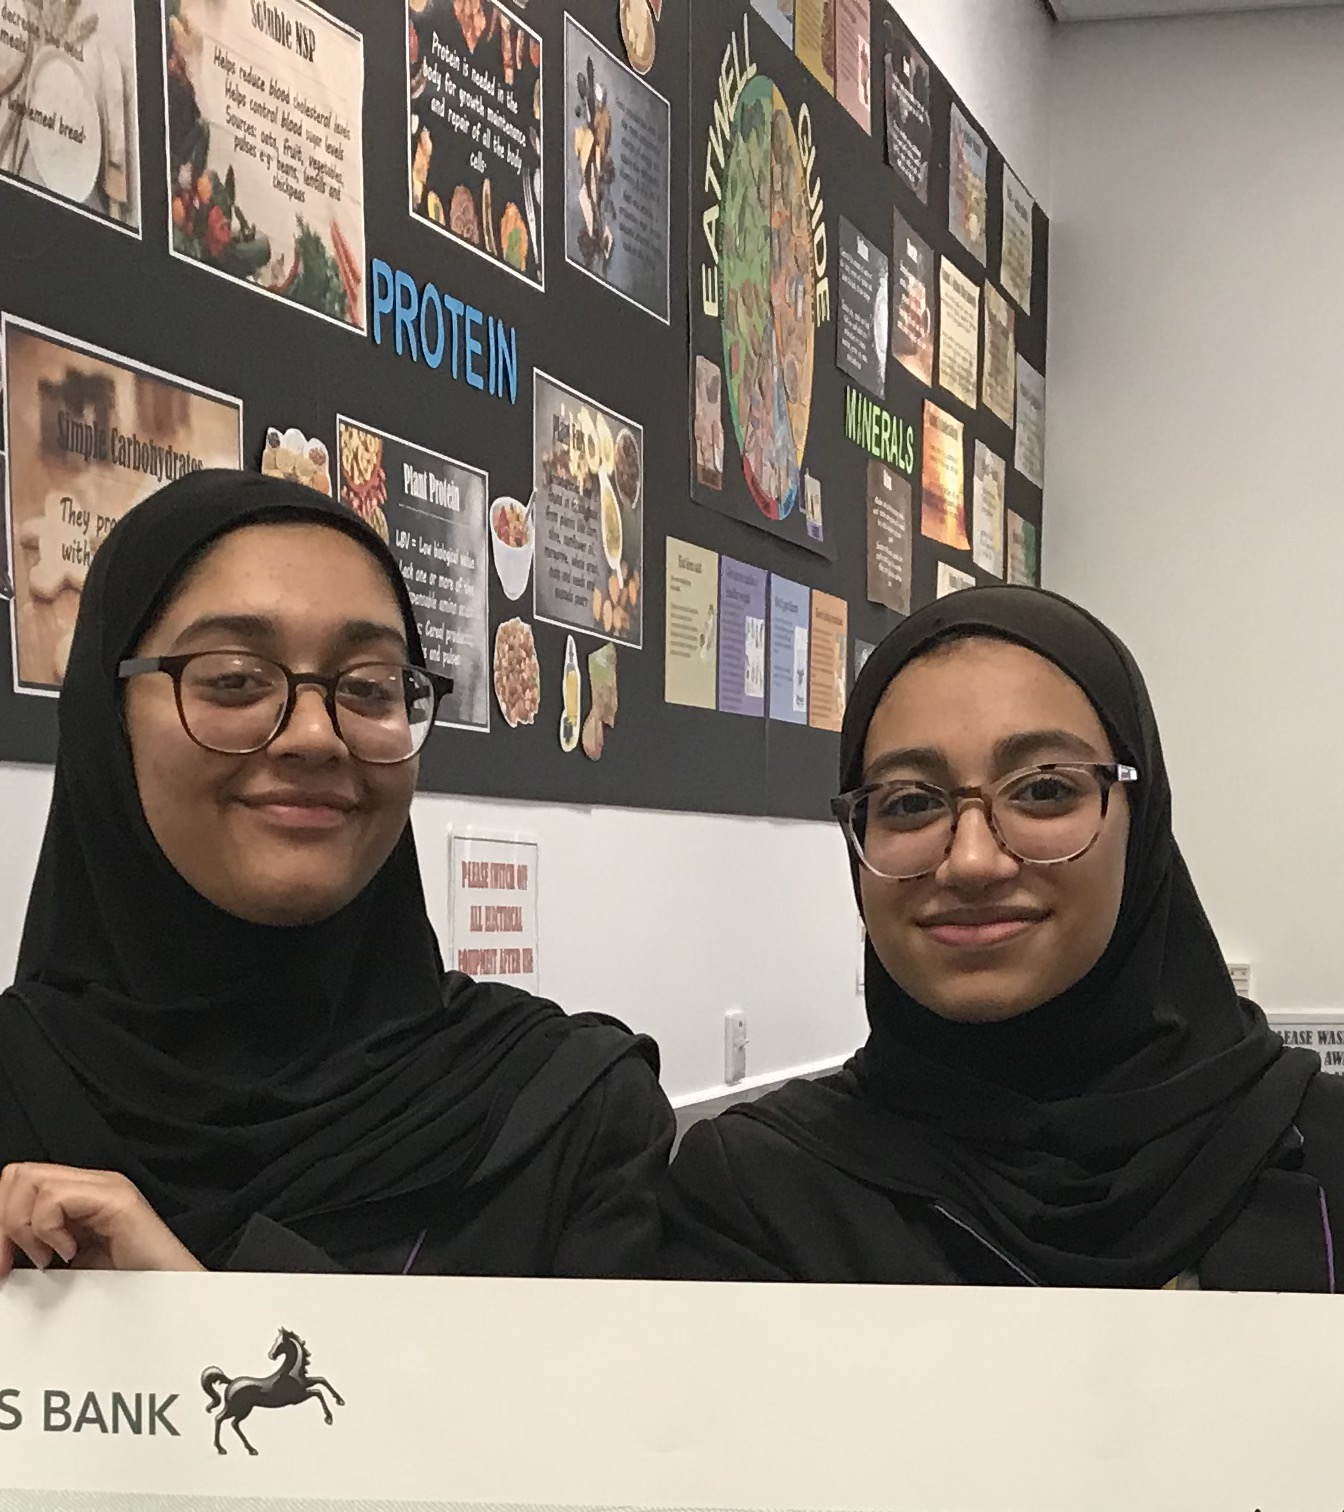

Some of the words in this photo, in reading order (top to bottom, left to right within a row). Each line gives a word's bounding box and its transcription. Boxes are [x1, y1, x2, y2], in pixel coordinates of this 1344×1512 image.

[295, 20, 316, 62] NSP
[213, 45, 236, 76] Helps
[239, 66, 265, 92] reduce
[269, 77, 290, 104] blood
[293, 93, 332, 129] cholesterol
[423, 56, 441, 91] body
[445, 72, 456, 96] for
[459, 88, 485, 117] growth
[432, 30, 460, 71] Protein
[462, 57, 469, 77] is
[471, 68, 495, 96] needed
[497, 83, 504, 104] in
[506, 91, 518, 114] the
[225, 77, 246, 109] Helps
[250, 99, 278, 124] control
[281, 110, 302, 137] blood
[325, 135, 344, 160] levels
[234, 134, 256, 158] pulses
[431, 97, 445, 117] and
[448, 109, 469, 132] repair
[472, 122, 481, 142] of
[482, 128, 491, 149] all
[493, 135, 504, 158] the
[506, 143, 522, 175] body
[799, 102, 830, 327] GUIDE
[372, 258, 518, 404] PROTEIN
[58, 410, 106, 462] Simple
[845, 385, 914, 474] MINERALS
[60, 497, 90, 535] They
[403, 463, 427, 500] Plant
[429, 472, 460, 512] Protein
[1278, 1030, 1313, 1045] EASE
[43, 1389, 182, 1437] BANK
